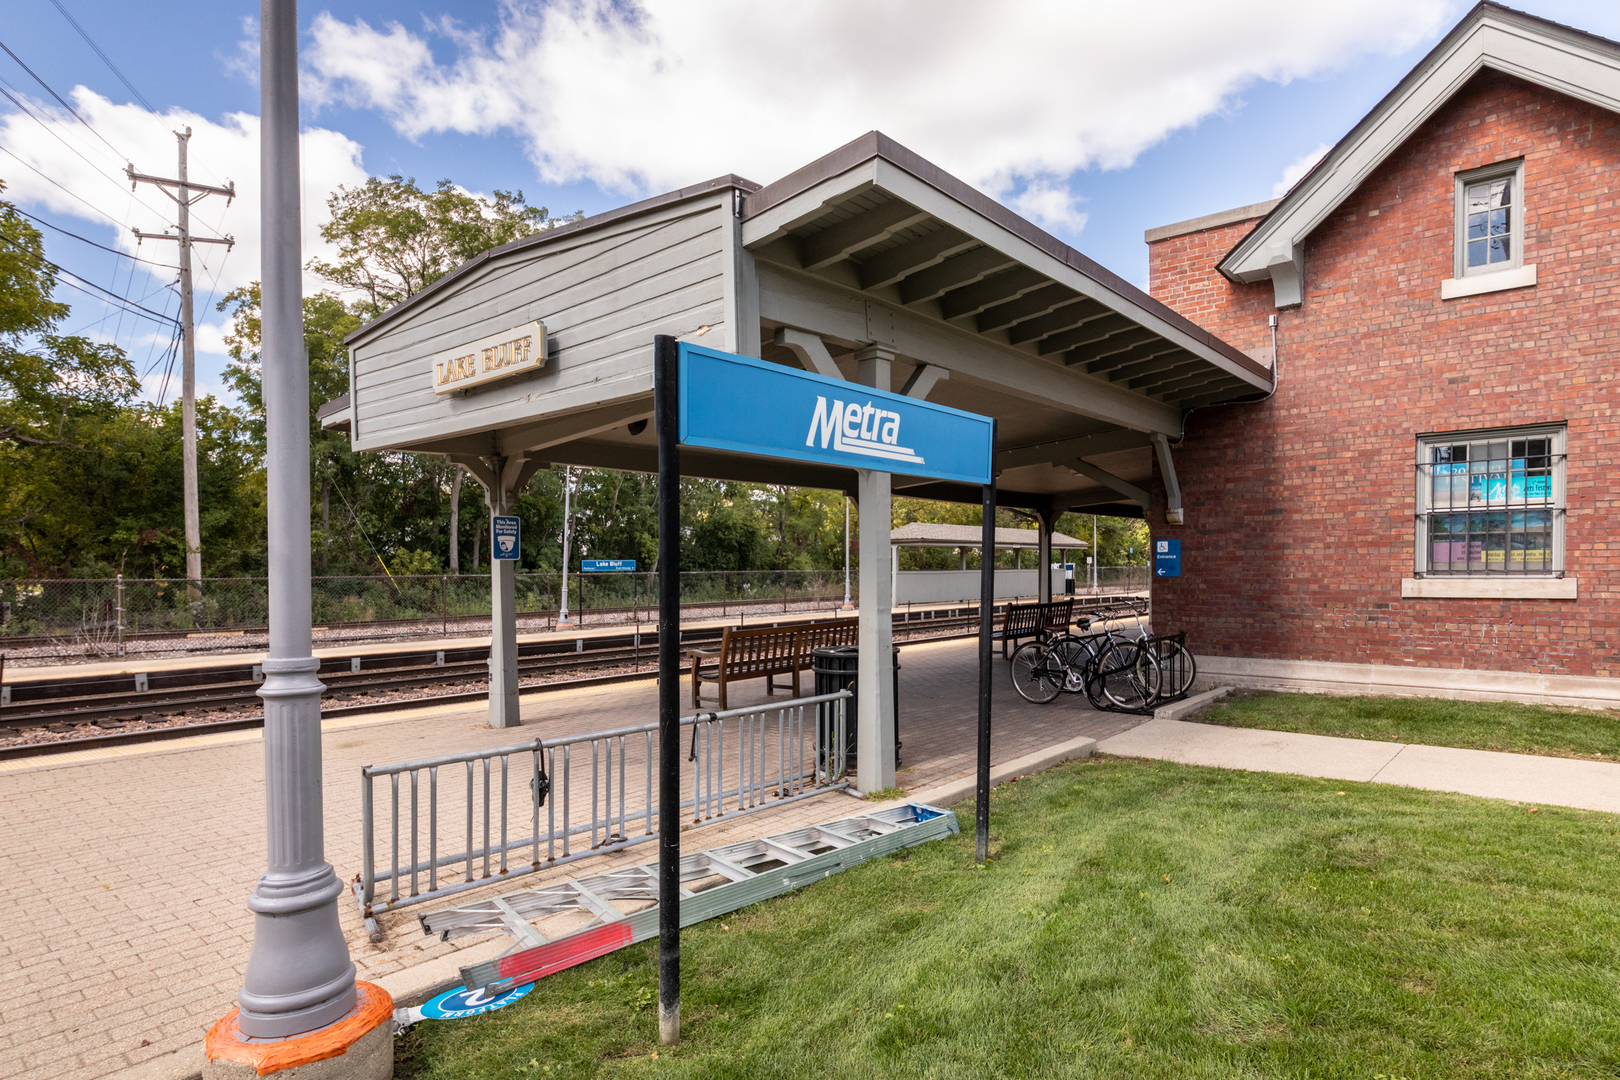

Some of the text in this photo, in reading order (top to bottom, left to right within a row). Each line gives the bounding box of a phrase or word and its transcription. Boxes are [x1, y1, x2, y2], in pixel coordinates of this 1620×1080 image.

[436, 335, 532, 386] LAKE BLUFF
[806, 396, 908, 454] Metra
[440, 992, 524, 1018] PLATFORM
